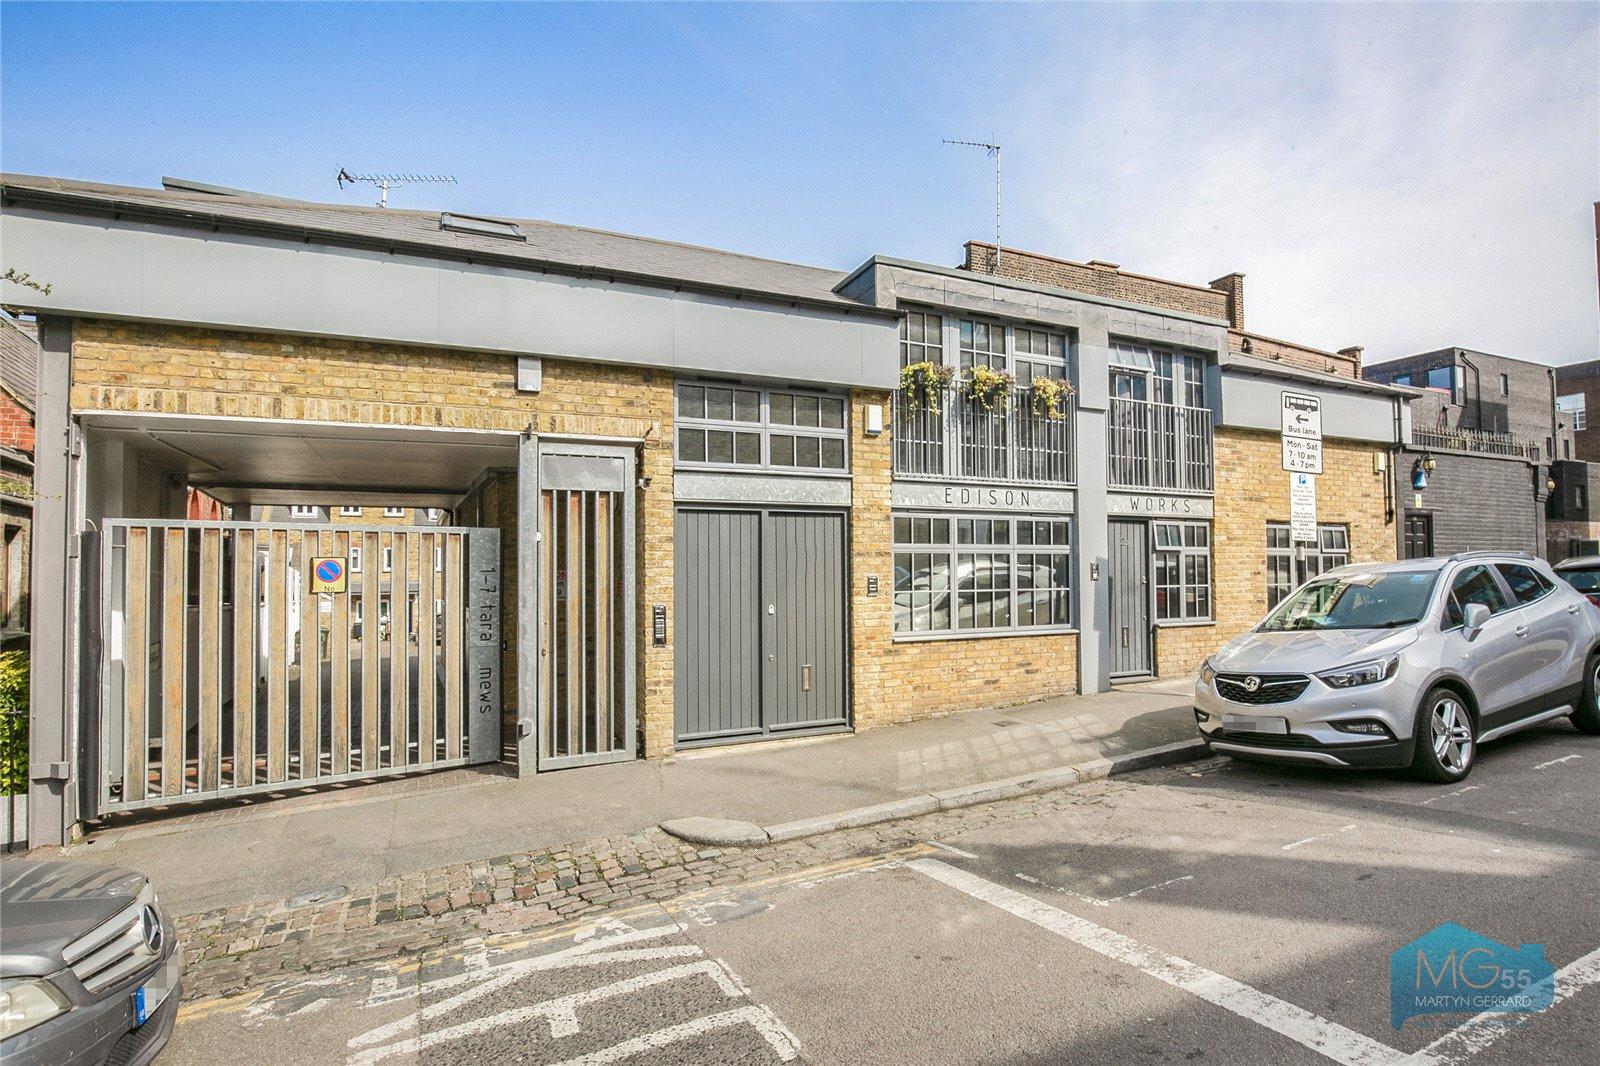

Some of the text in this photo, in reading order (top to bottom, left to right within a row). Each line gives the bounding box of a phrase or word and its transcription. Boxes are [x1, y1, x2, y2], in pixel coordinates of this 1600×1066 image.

[1288, 424, 1317, 436] Bus lane
[1286, 440, 1301, 449] Mon
[1306, 442, 1318, 451] Sat
[945, 487, 1191, 513] EDISON WORKS
[479, 567, 496, 714] 1-7 tara mews
